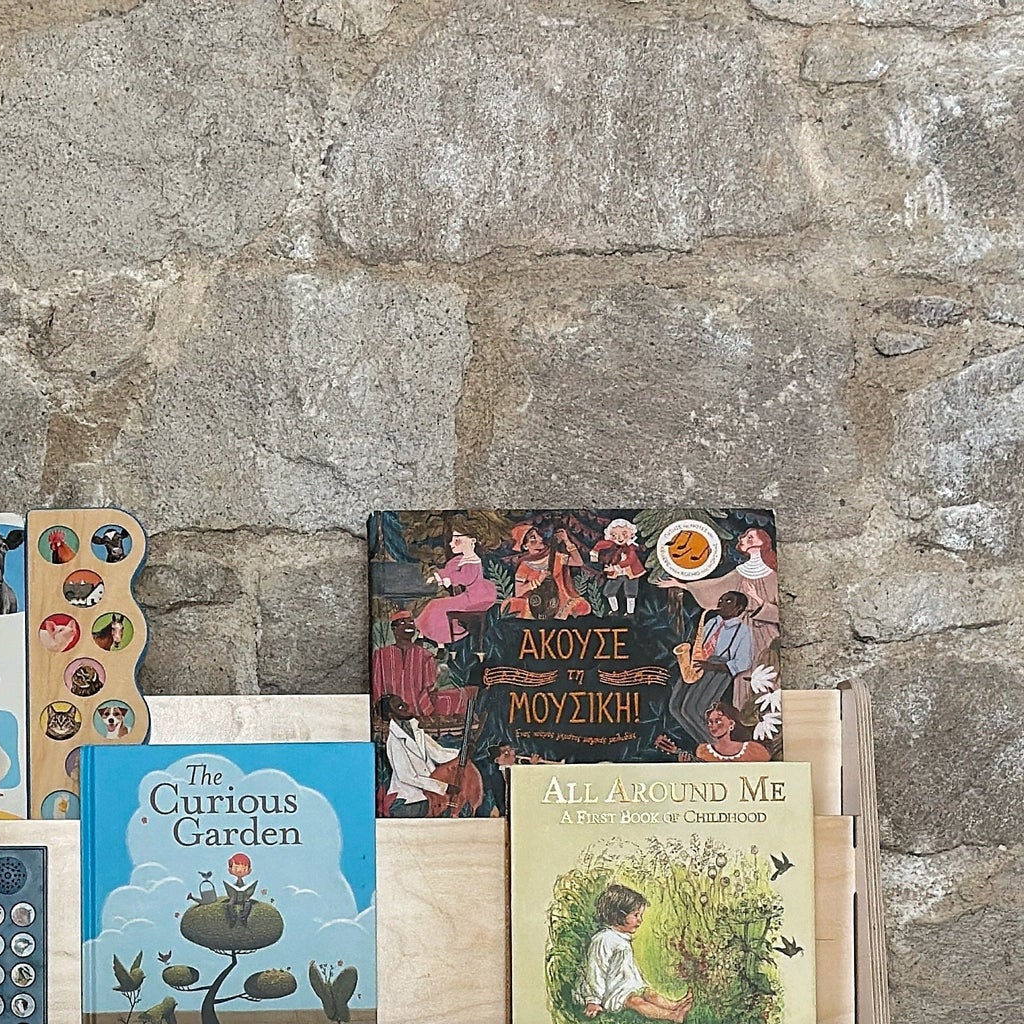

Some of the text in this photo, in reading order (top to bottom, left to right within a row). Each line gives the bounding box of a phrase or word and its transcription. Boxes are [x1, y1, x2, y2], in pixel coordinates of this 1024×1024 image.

[518, 628, 630, 662] ΑΚΟΥΣΕ
[567, 668, 585, 685] τη
[508, 690, 641, 725] ΜΟΥΣΙΚΗ!
[185, 763, 223, 786] The
[149, 782, 298, 815] Curious
[540, 775, 786, 804] ALL AROUND ME
[173, 816, 303, 846] Garden
[559, 811, 573, 824] A
[576, 810, 616, 824] FIRST
[619, 809, 659, 824] BOOK
[684, 810, 767, 823] CHILDHOOD
